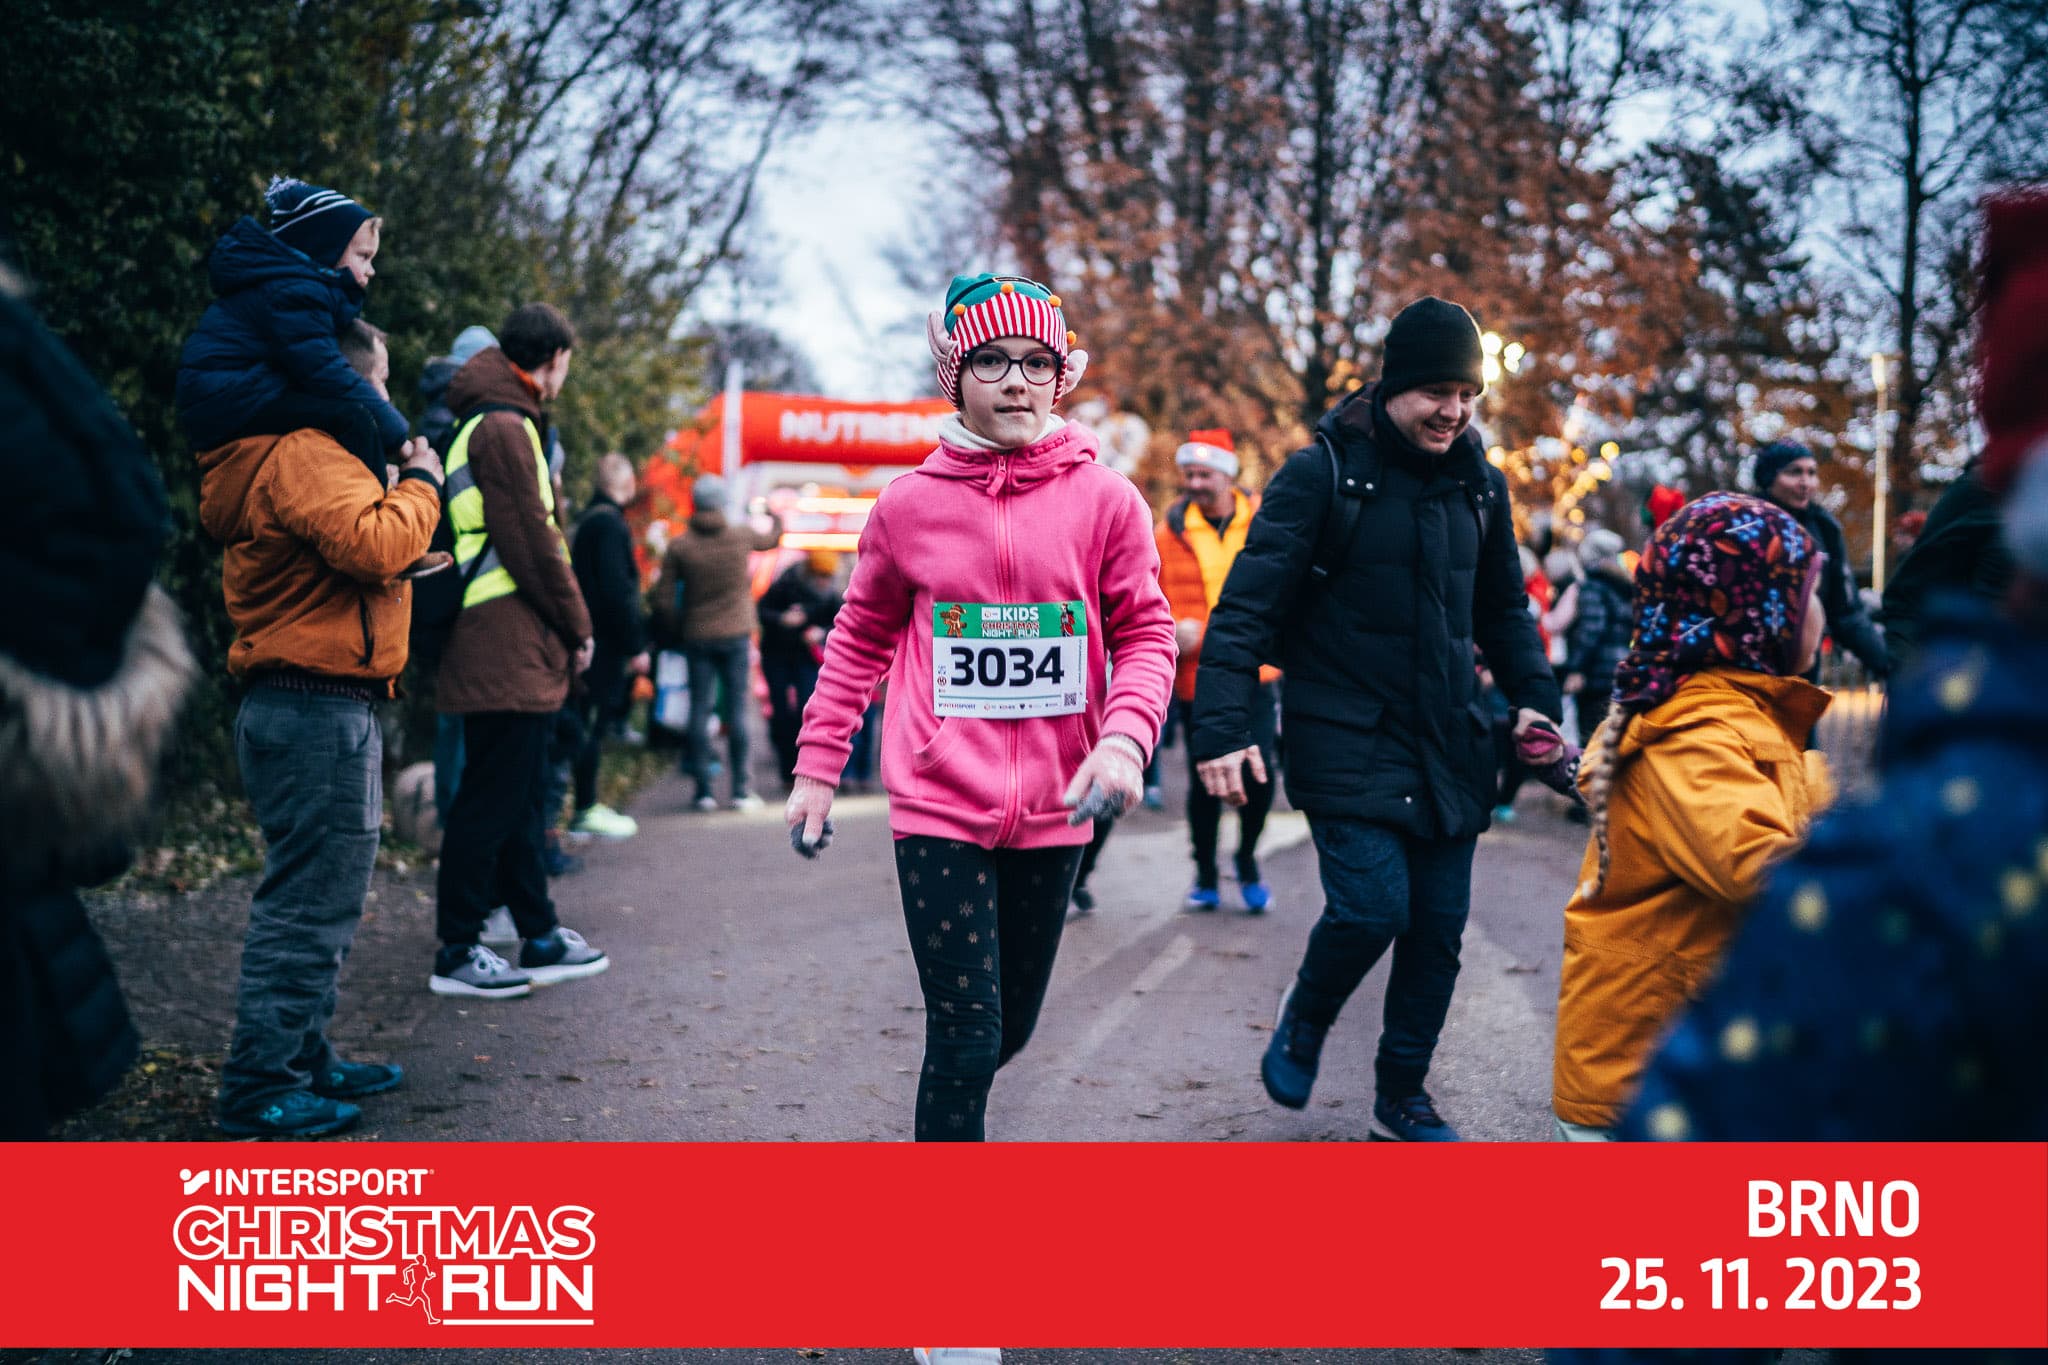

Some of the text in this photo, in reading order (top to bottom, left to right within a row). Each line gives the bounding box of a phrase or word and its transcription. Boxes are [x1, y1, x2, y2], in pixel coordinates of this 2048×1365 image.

[779, 411, 941, 444] NUTREN
[1002, 606, 1040, 621] KIDS
[982, 621, 1040, 631] CHRISTMAS
[982, 629, 1040, 639] NIGHT RUN
[951, 646, 1065, 687] 3034
